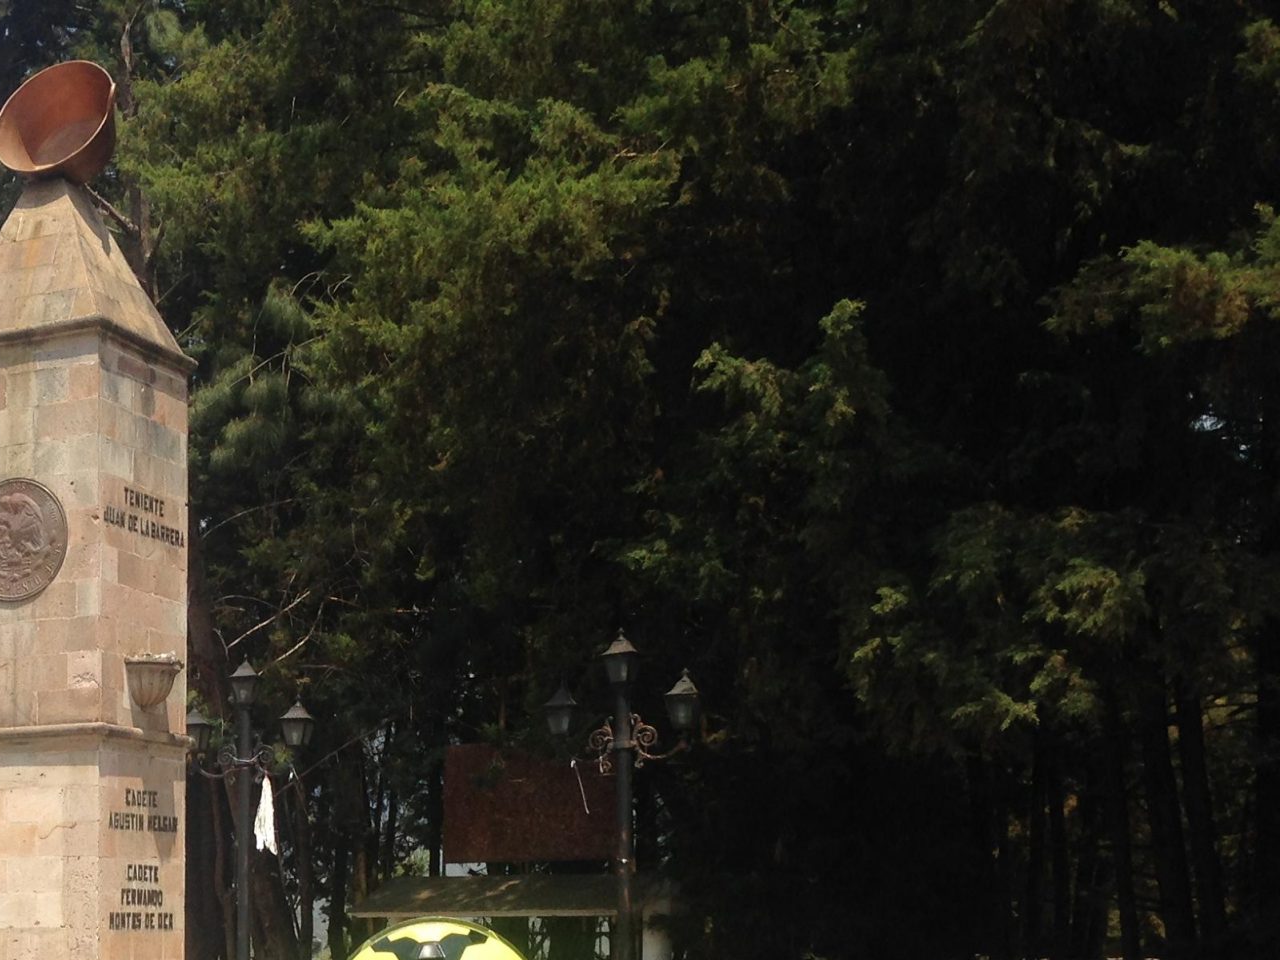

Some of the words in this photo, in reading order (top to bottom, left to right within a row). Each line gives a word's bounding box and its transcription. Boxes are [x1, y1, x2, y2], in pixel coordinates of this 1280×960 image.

[124, 487, 165, 517] TENIENTE
[103, 505, 126, 528] JUAN
[128, 514, 138, 533] DE
[140, 517, 150, 538] LA
[150, 521, 184, 548] BARRERA
[125, 788, 159, 808] CADETE
[108, 811, 144, 830] AGUSTIN
[127, 864, 159, 883] CADETE
[121, 888, 163, 906] FERNANDO
[109, 912, 142, 930] MONTES
[144, 912, 154, 930] DE
[157, 912, 174, 930] OCA
